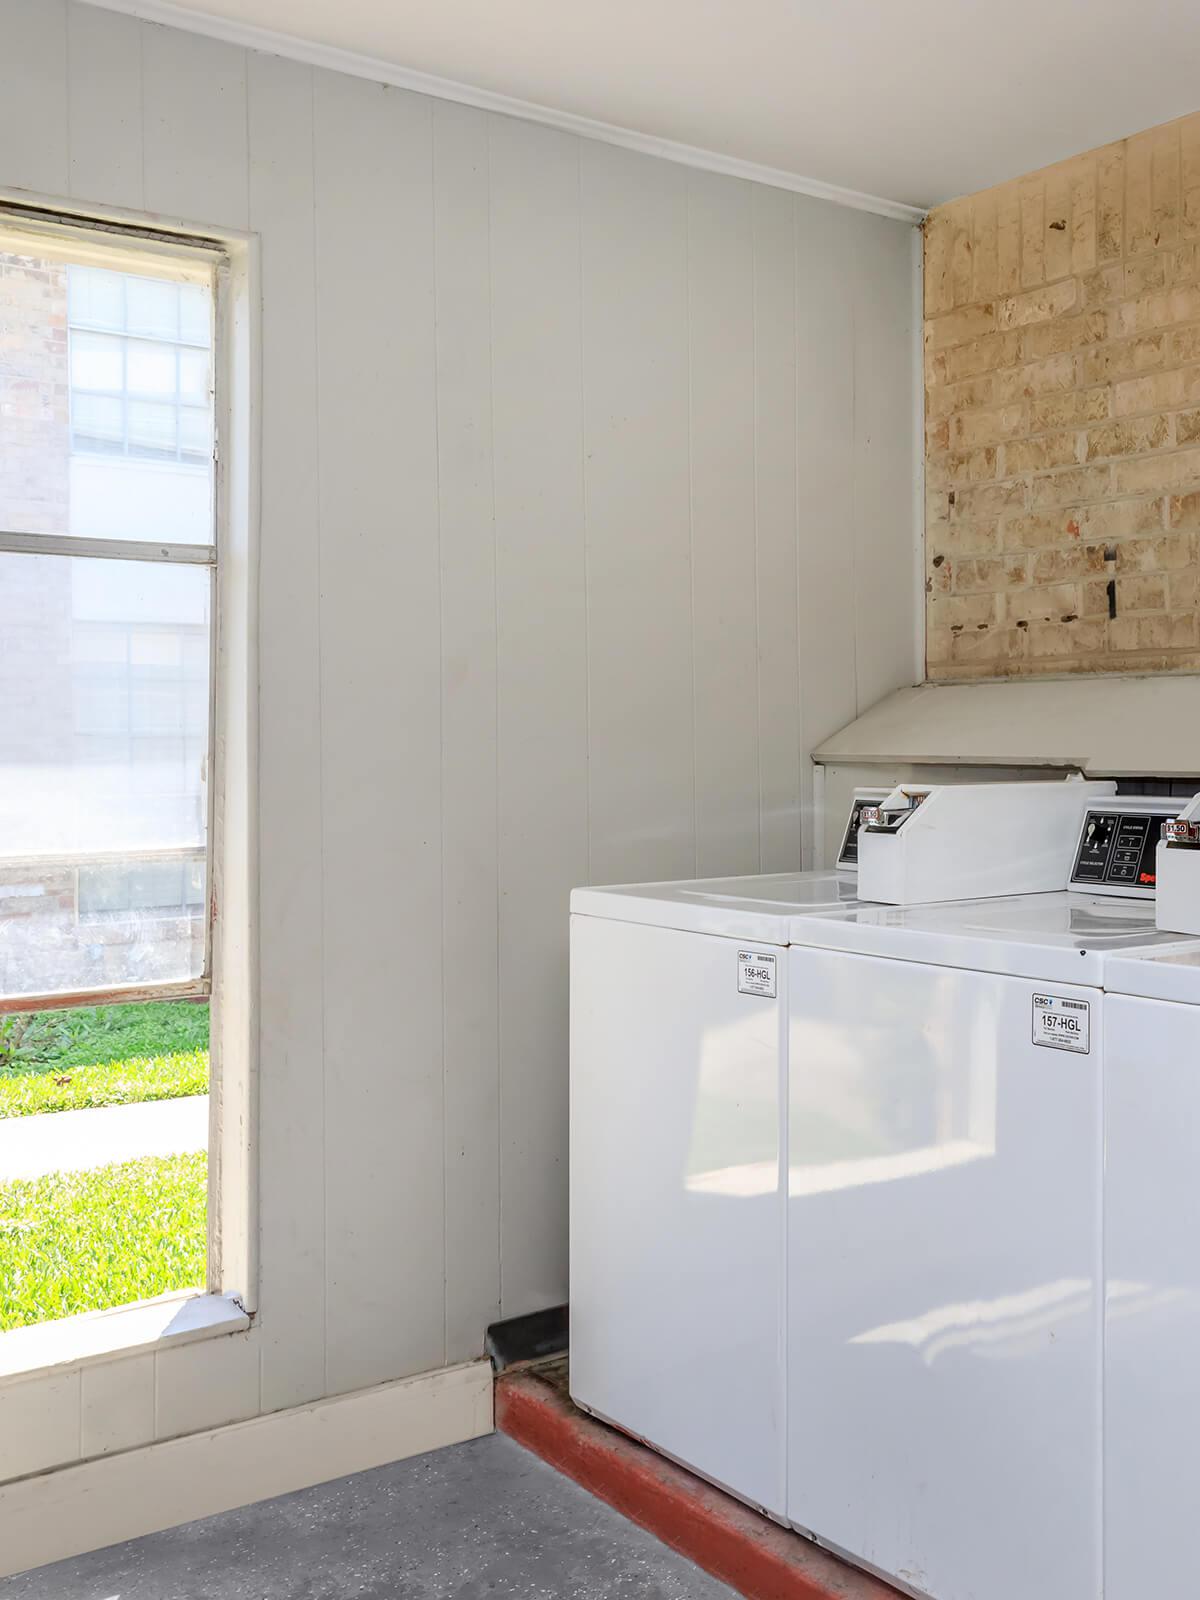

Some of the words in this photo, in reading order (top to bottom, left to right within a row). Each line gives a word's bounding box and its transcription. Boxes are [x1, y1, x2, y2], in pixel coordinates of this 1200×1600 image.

[1106, 579, 1117, 620] 1
[1034, 997, 1049, 1005] CSC
[1042, 1014, 1081, 1032] 157-HGL
